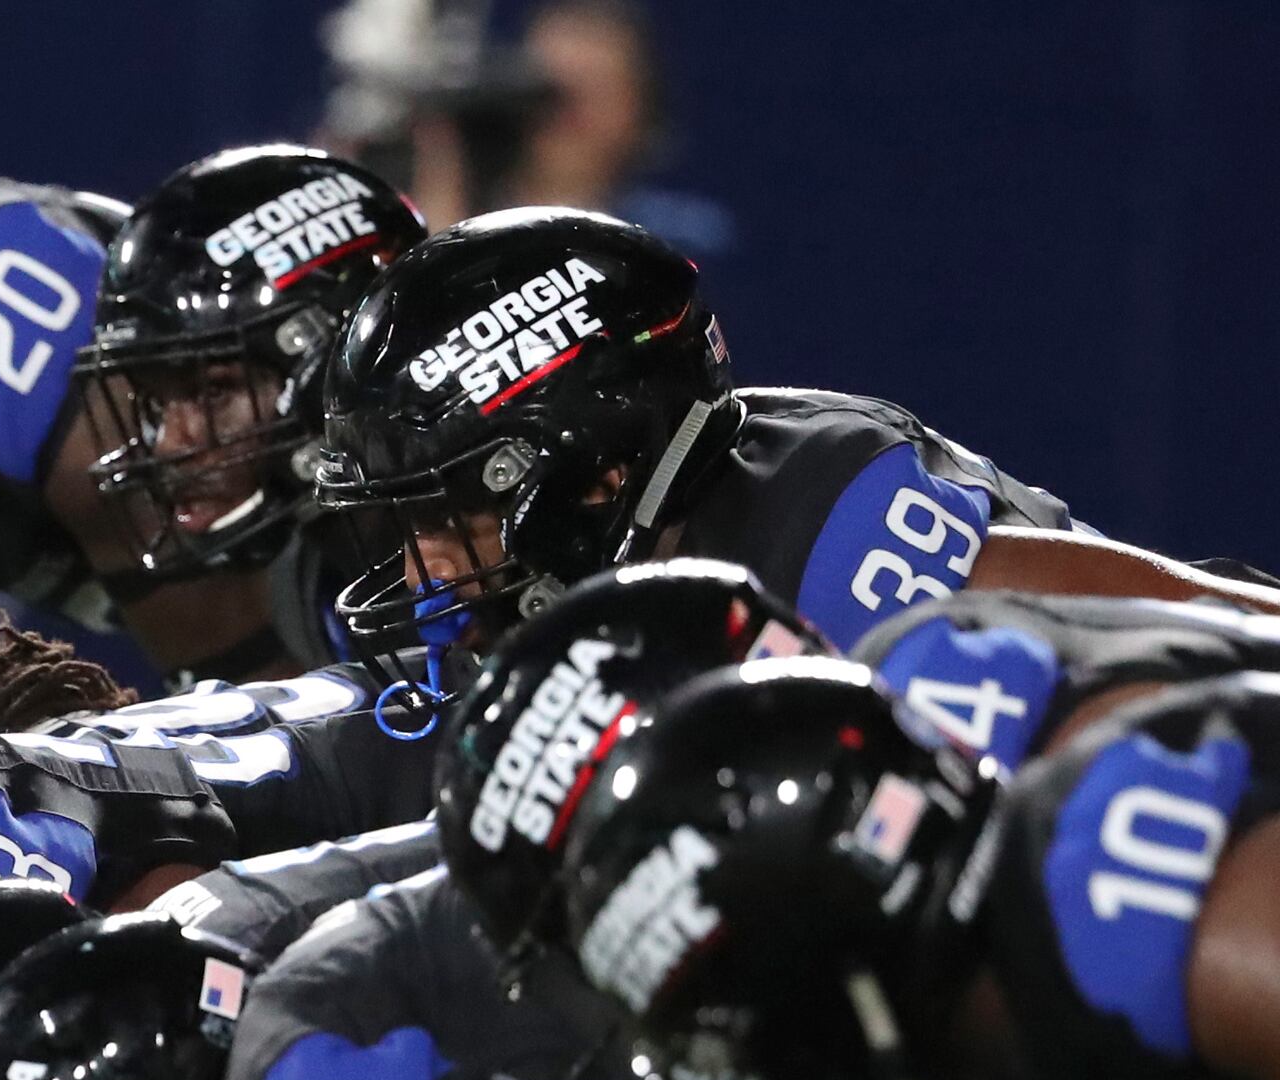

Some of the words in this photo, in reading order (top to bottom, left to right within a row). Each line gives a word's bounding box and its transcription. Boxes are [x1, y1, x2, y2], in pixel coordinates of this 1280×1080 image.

[206, 171, 373, 267] GEORGIA
[254, 201, 378, 281] STATE
[408, 256, 607, 393] GEORGIA
[458, 297, 604, 406] STATE
[850, 486, 984, 613] 39
[471, 637, 618, 853] GEORGIA
[512, 677, 625, 845] STATE
[1087, 784, 1229, 922] 10
